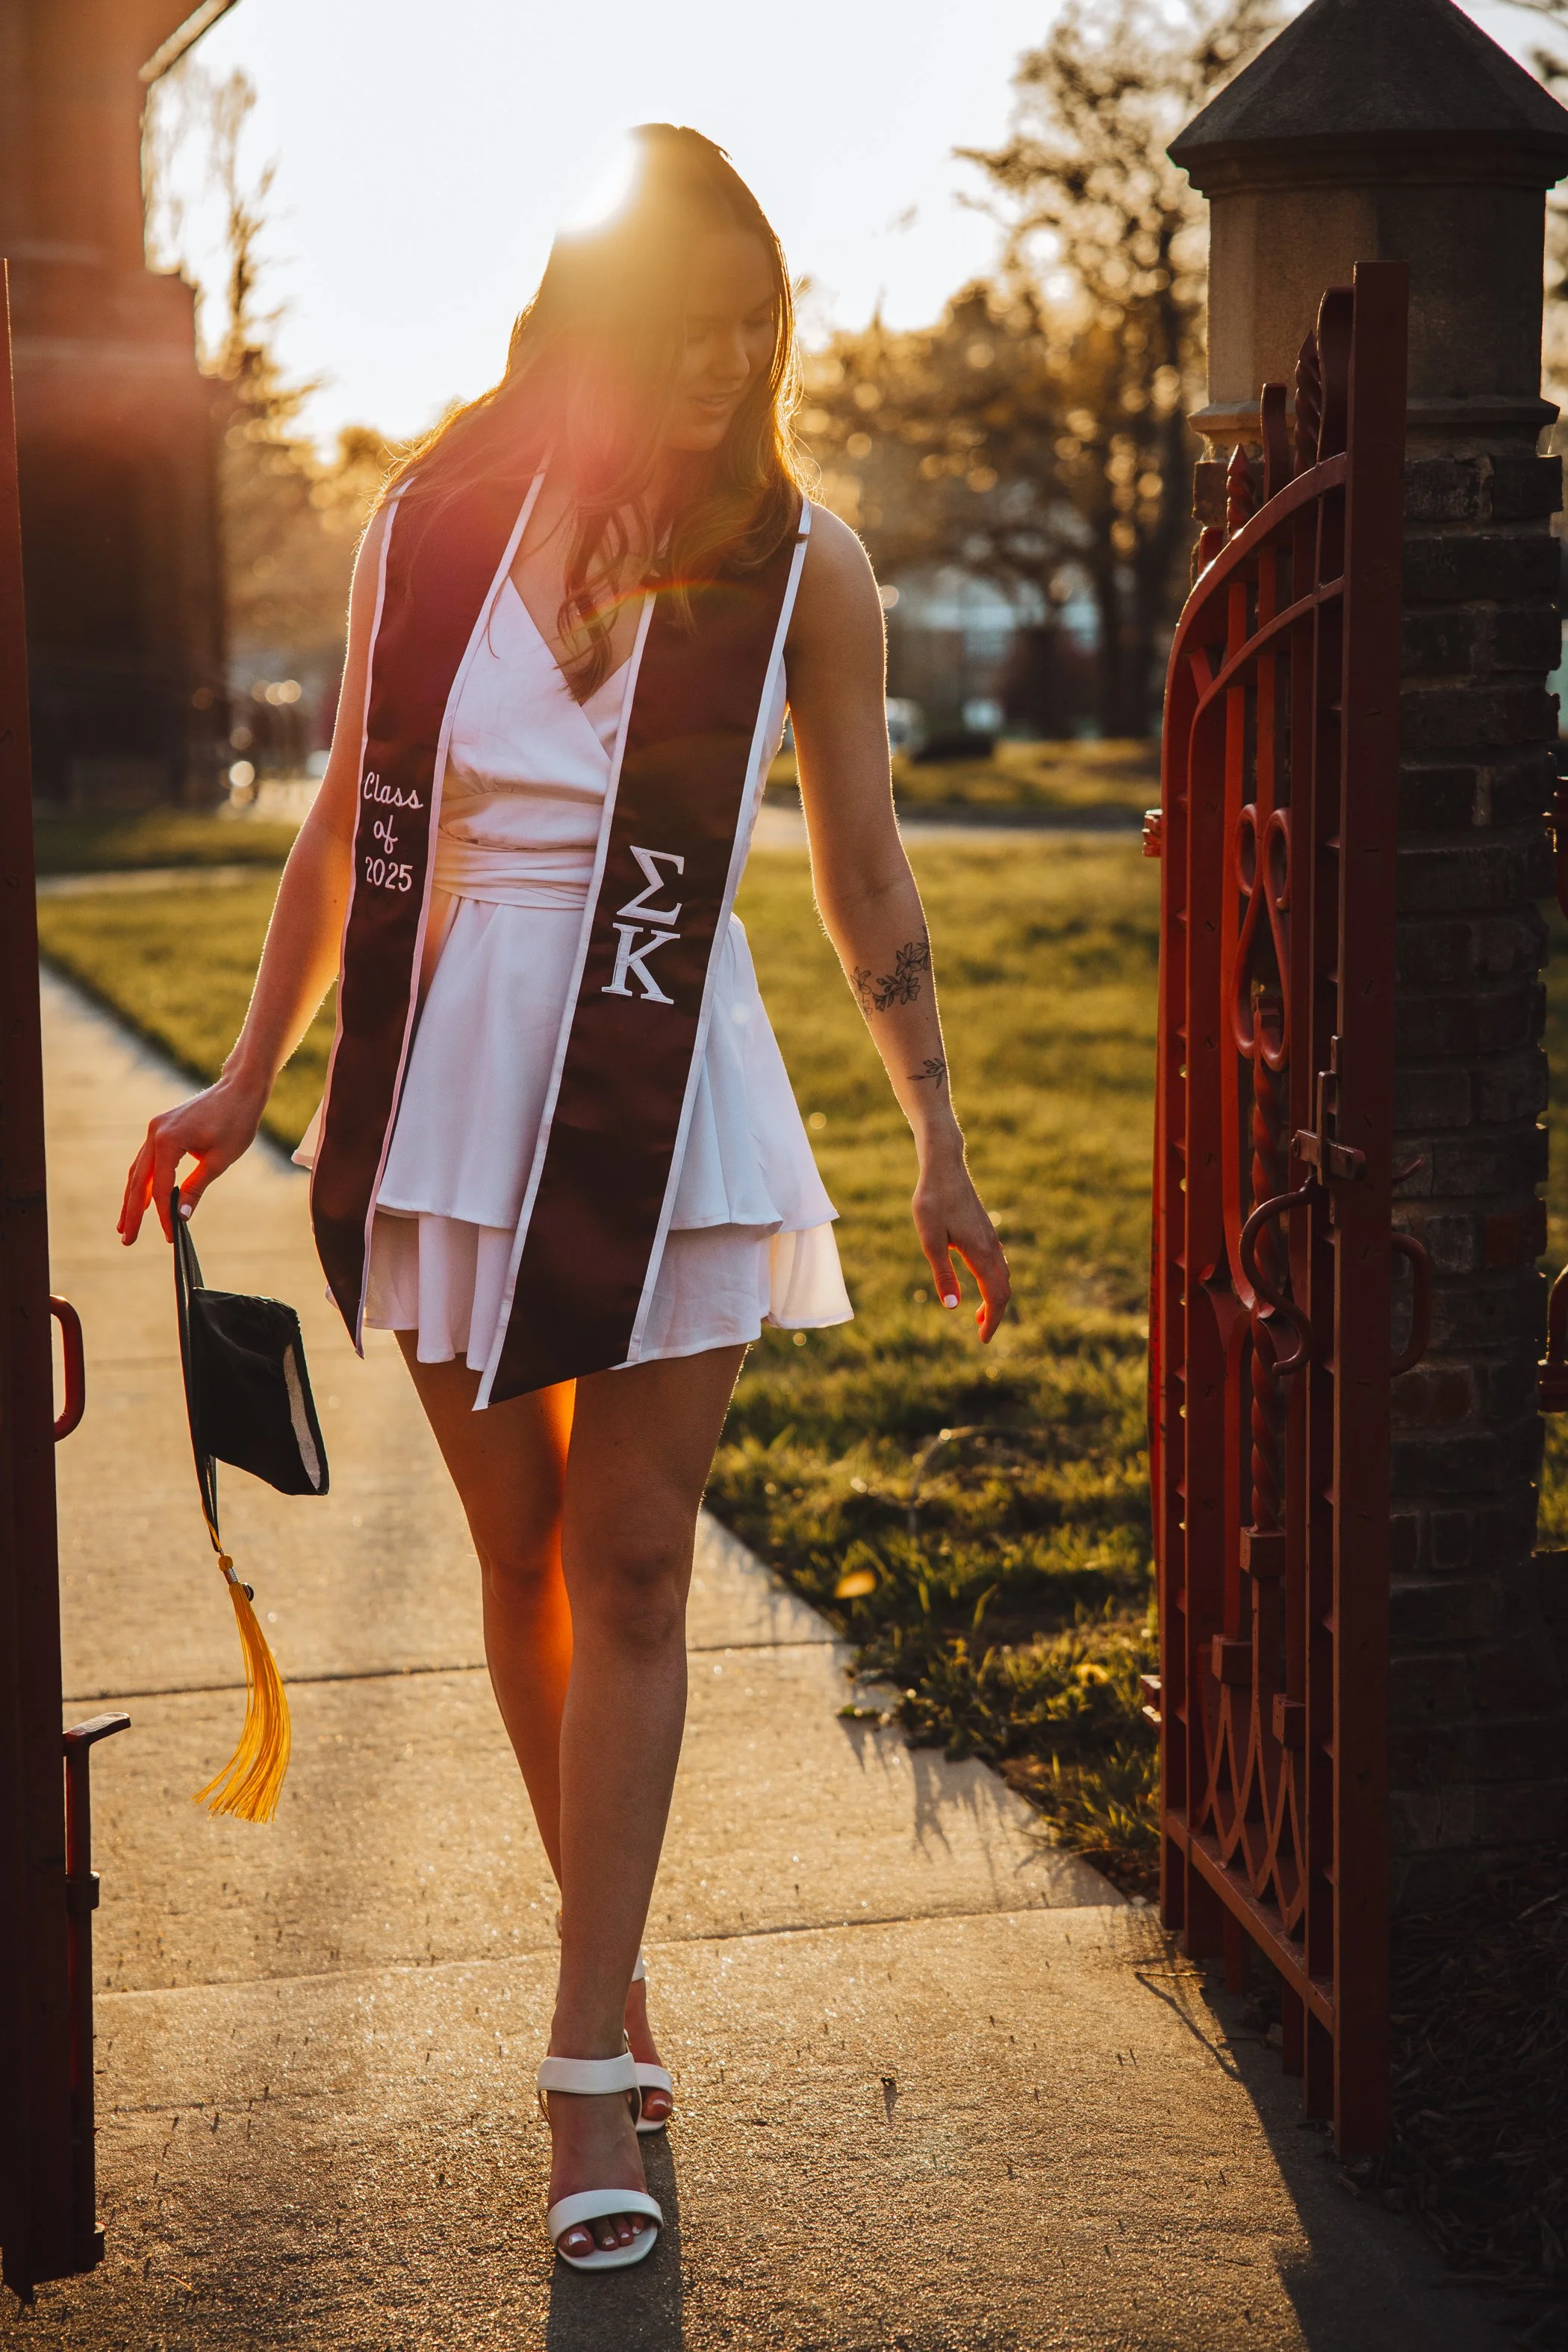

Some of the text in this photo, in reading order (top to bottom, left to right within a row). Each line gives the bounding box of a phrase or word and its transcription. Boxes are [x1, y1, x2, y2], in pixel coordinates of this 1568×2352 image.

[364, 771, 423, 808] Class
[374, 815, 398, 854] of
[365, 856, 413, 892] 2025
[617, 845, 685, 925] Σ
